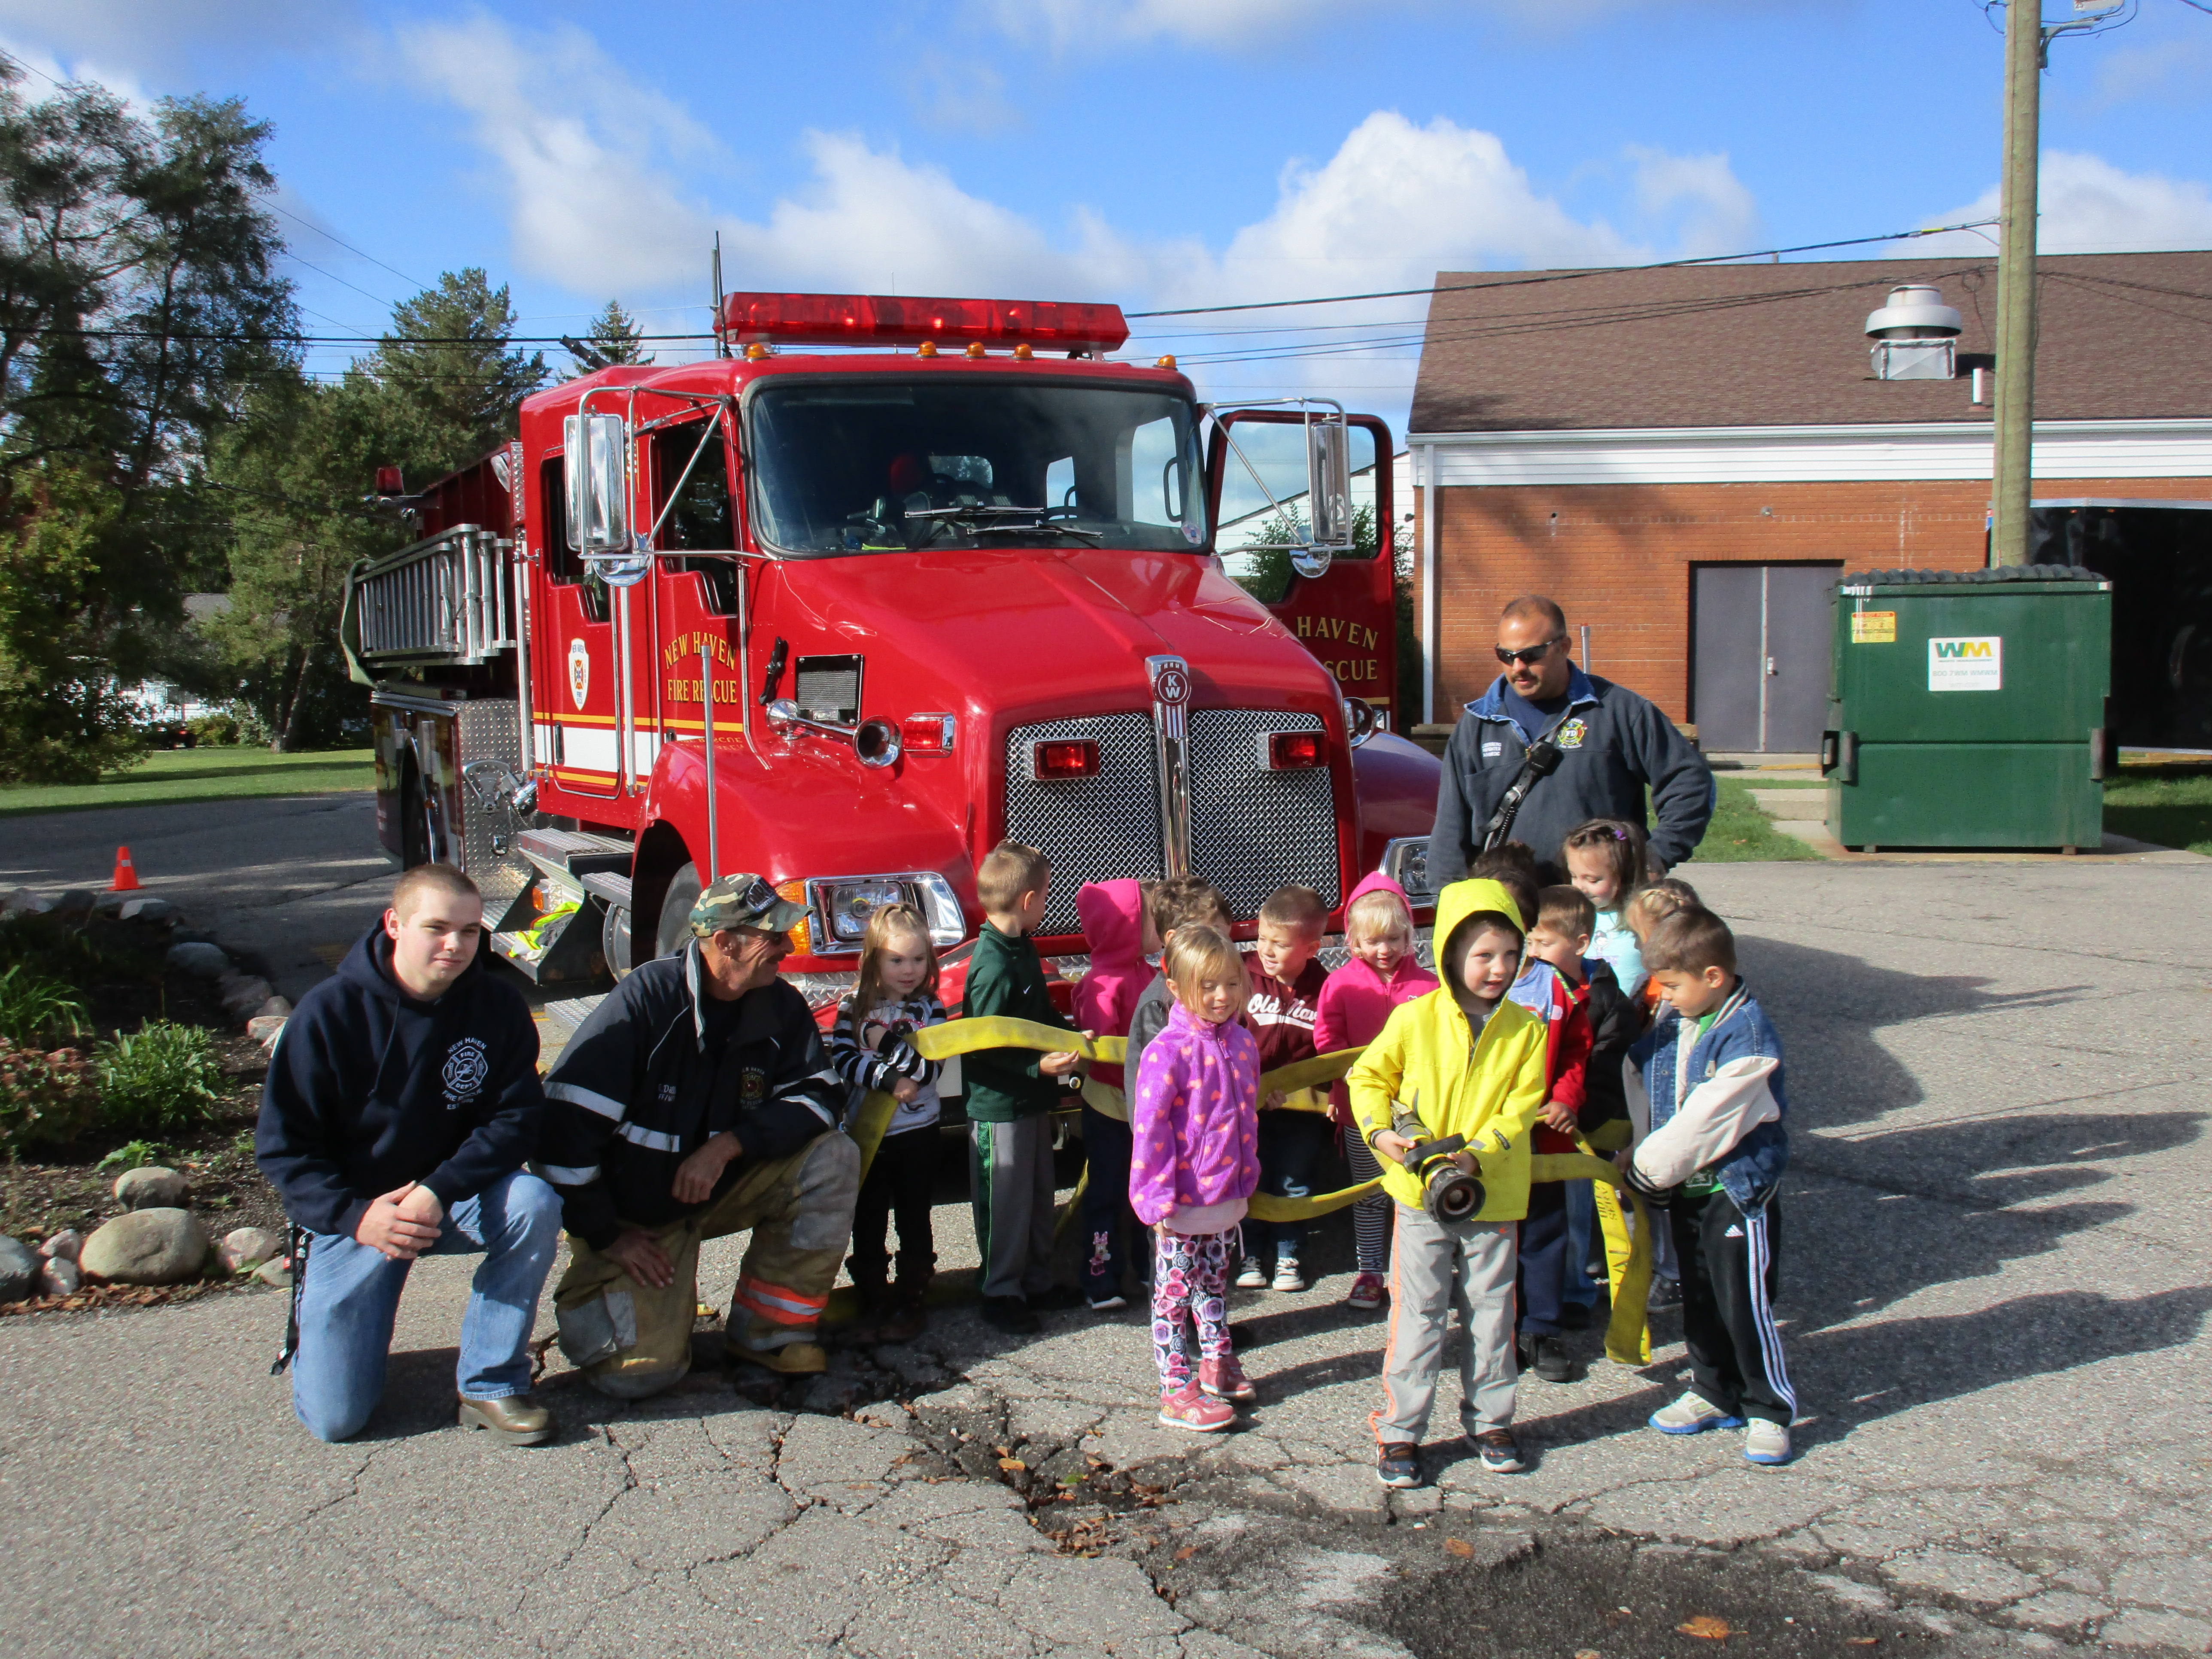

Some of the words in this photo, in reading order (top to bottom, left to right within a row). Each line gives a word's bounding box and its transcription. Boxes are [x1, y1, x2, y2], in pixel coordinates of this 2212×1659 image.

[1297, 616, 1379, 650] HAVEN
[665, 633, 688, 670] NEW
[1935, 642, 1993, 658] WM
[1323, 659, 1378, 681] SCUE
[1168, 675, 1178, 687] K
[667, 679, 689, 701] FIRE
[692, 680, 737, 703] RECUE
[1165, 687, 1181, 699] W
[1247, 993, 1281, 1014] Old
[1286, 998, 1318, 1021] Nav
[447, 1040, 463, 1054] NEW
[465, 1037, 487, 1050] HAVEN
[442, 1090, 457, 1102] FIRE
